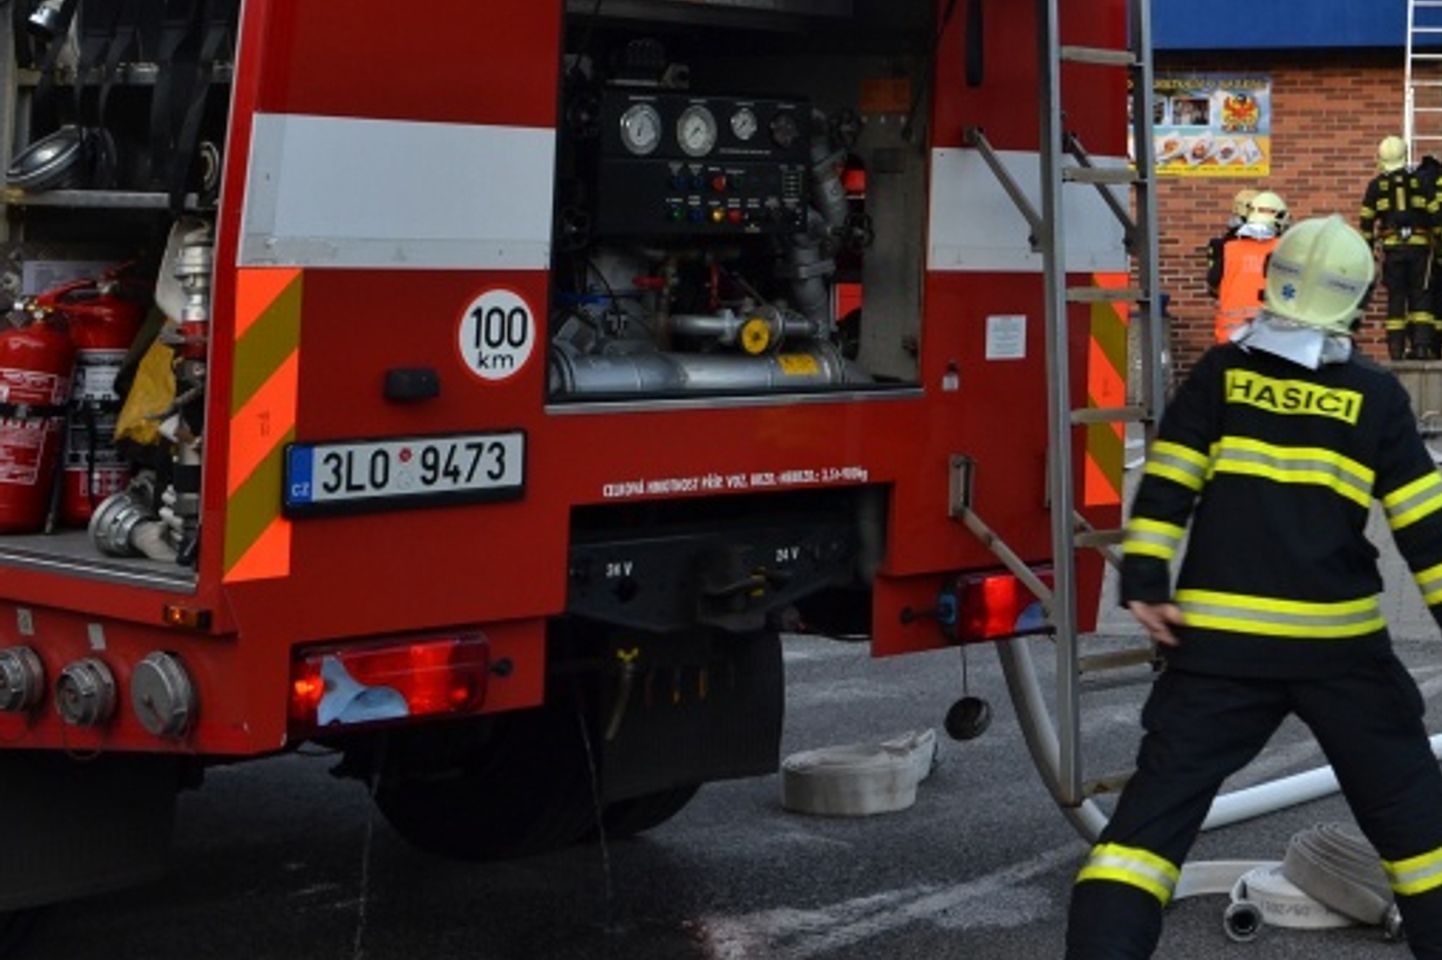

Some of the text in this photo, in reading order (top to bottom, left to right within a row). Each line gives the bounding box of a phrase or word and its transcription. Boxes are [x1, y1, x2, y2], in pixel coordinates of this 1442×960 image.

[470, 306, 528, 349] 100
[477, 351, 515, 370] km
[420, 442, 506, 486] 9473
[291, 481, 311, 498] CZ
